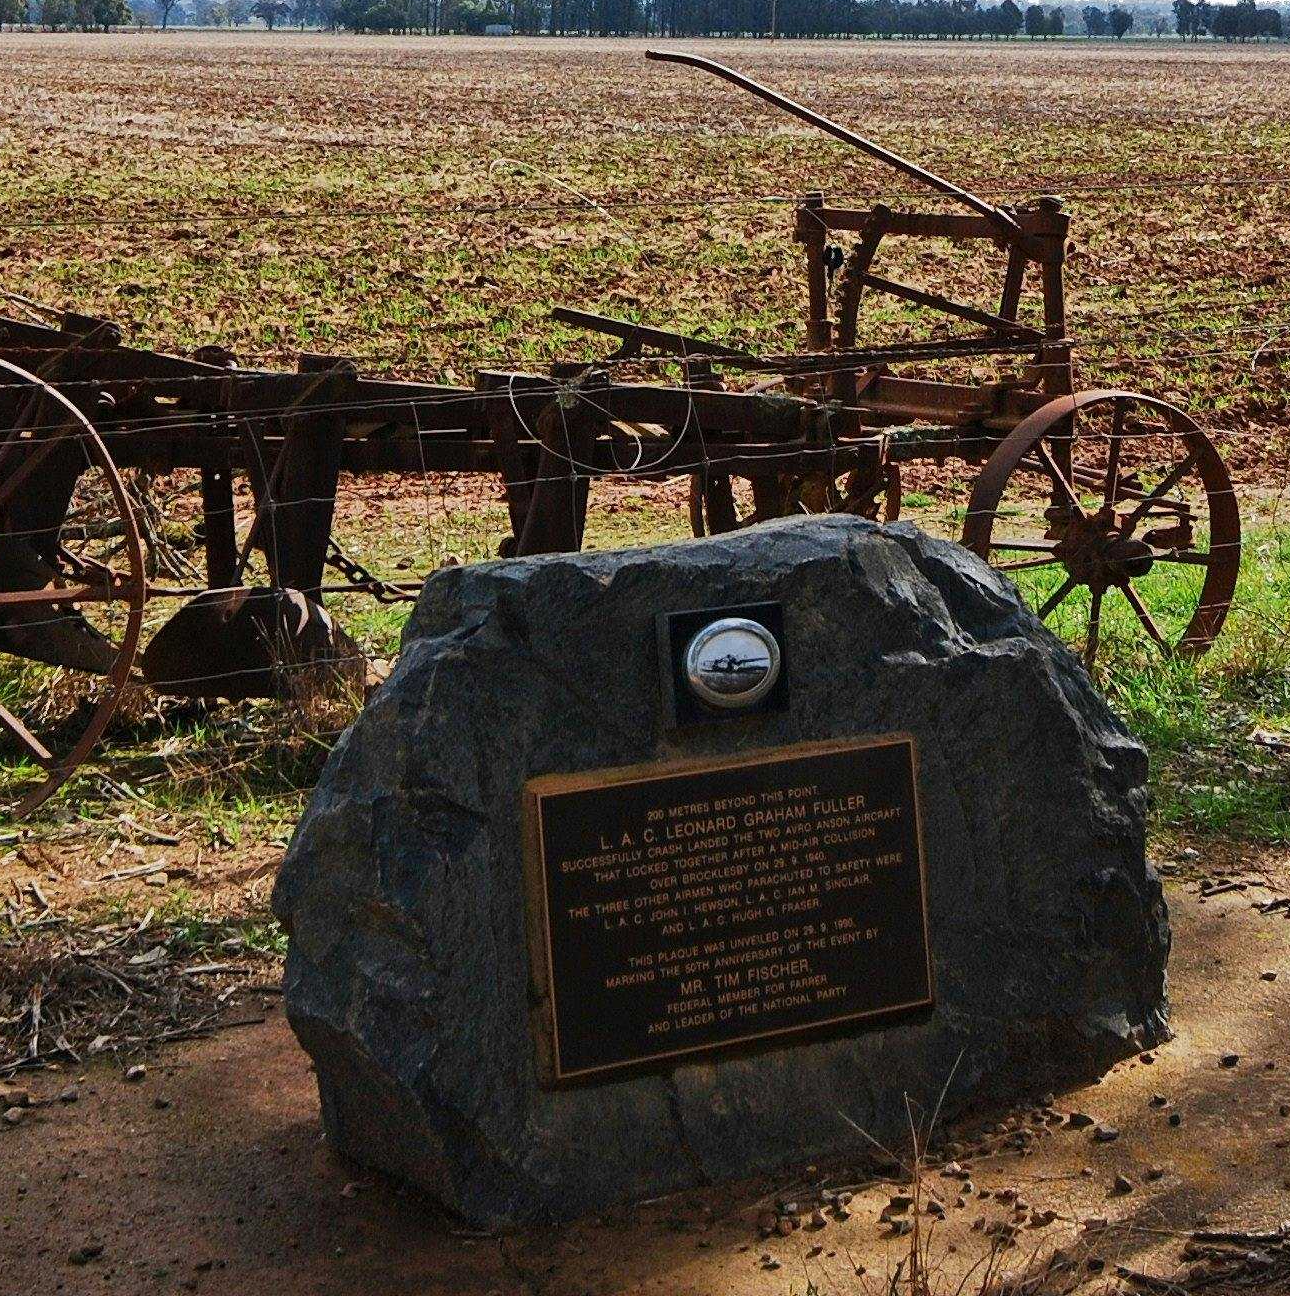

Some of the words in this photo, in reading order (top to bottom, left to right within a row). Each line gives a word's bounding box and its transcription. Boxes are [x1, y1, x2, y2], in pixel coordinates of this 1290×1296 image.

[645, 808, 664, 821] 200
[668, 801, 709, 818] METRES
[714, 794, 755, 810] BEYOND
[761, 790, 783, 803] THIS
[666, 814, 736, 840] LEONARD
[743, 803, 806, 827] GRAHAM
[813, 794, 865, 816] FULLER
[560, 849, 642, 873] SUCCESSFULLY
[647, 842, 682, 858] CRASH
[687, 835, 728, 852] LANDED
[733, 831, 753, 844] THE
[758, 826, 780, 840] TWO
[785, 821, 811, 835] AVRO
[816, 815, 850, 830] ANSON
[854, 806, 901, 824] AIRCRAFT
[593, 869, 620, 883] THAT
[626, 861, 668, 878] LOCKED
[674, 851, 727, 870] TOGETHER
[732, 844, 764, 860] AFTER
[769, 843, 776, 853] A
[780, 835, 818, 852] MID-AIR
[823, 826, 876, 844] COLLISION
[567, 906, 589, 920] THE
[595, 899, 629, 915] THREE
[634, 892, 669, 908] OTHER
[674, 884, 713, 901] AIRMEN
[718, 879, 742, 894] WHO
[747, 867, 813, 888] PARACHUTED
[818, 864, 830, 876] TO
[835, 857, 870, 873] SAFETY
[875, 851, 902, 866] WERE
[649, 875, 677, 890] OVER
[682, 863, 749, 884] BROCKLESBY
[753, 860, 769, 872] ON
[650, 907, 678, 922] JOHN
[788, 884, 805, 898] IAN
[660, 922, 683, 936] AND
[732, 908, 761, 923] HUGH
[605, 970, 654, 989] MARKING
[660, 965, 679, 978] THE
[714, 945, 783, 968] ANNIVERSARY
[788, 942, 800, 954] OF
[806, 937, 825, 950] THE
[830, 930, 861, 946] EVENT
[866, 927, 879, 939] BY
[627, 954, 652, 969] THIS
[657, 945, 698, 963] PLAQUE
[703, 940, 724, 954] WAS
[730, 930, 779, 949] UNVEILED
[783, 926, 798, 939] ON
[665, 996, 712, 1015] FEDERAL
[717, 986, 760, 1005] MEMBER
[765, 981, 784, 995] FOR
[679, 977, 705, 996] MR.
[714, 971, 739, 989] TIM
[647, 1020, 670, 1035] AND
[675, 1011, 714, 1029] LEADER
[719, 1008, 732, 1020] OF
[738, 1003, 757, 1016] THE
[762, 992, 810, 1012] NATIONAL
[816, 985, 847, 1001] PARTY
